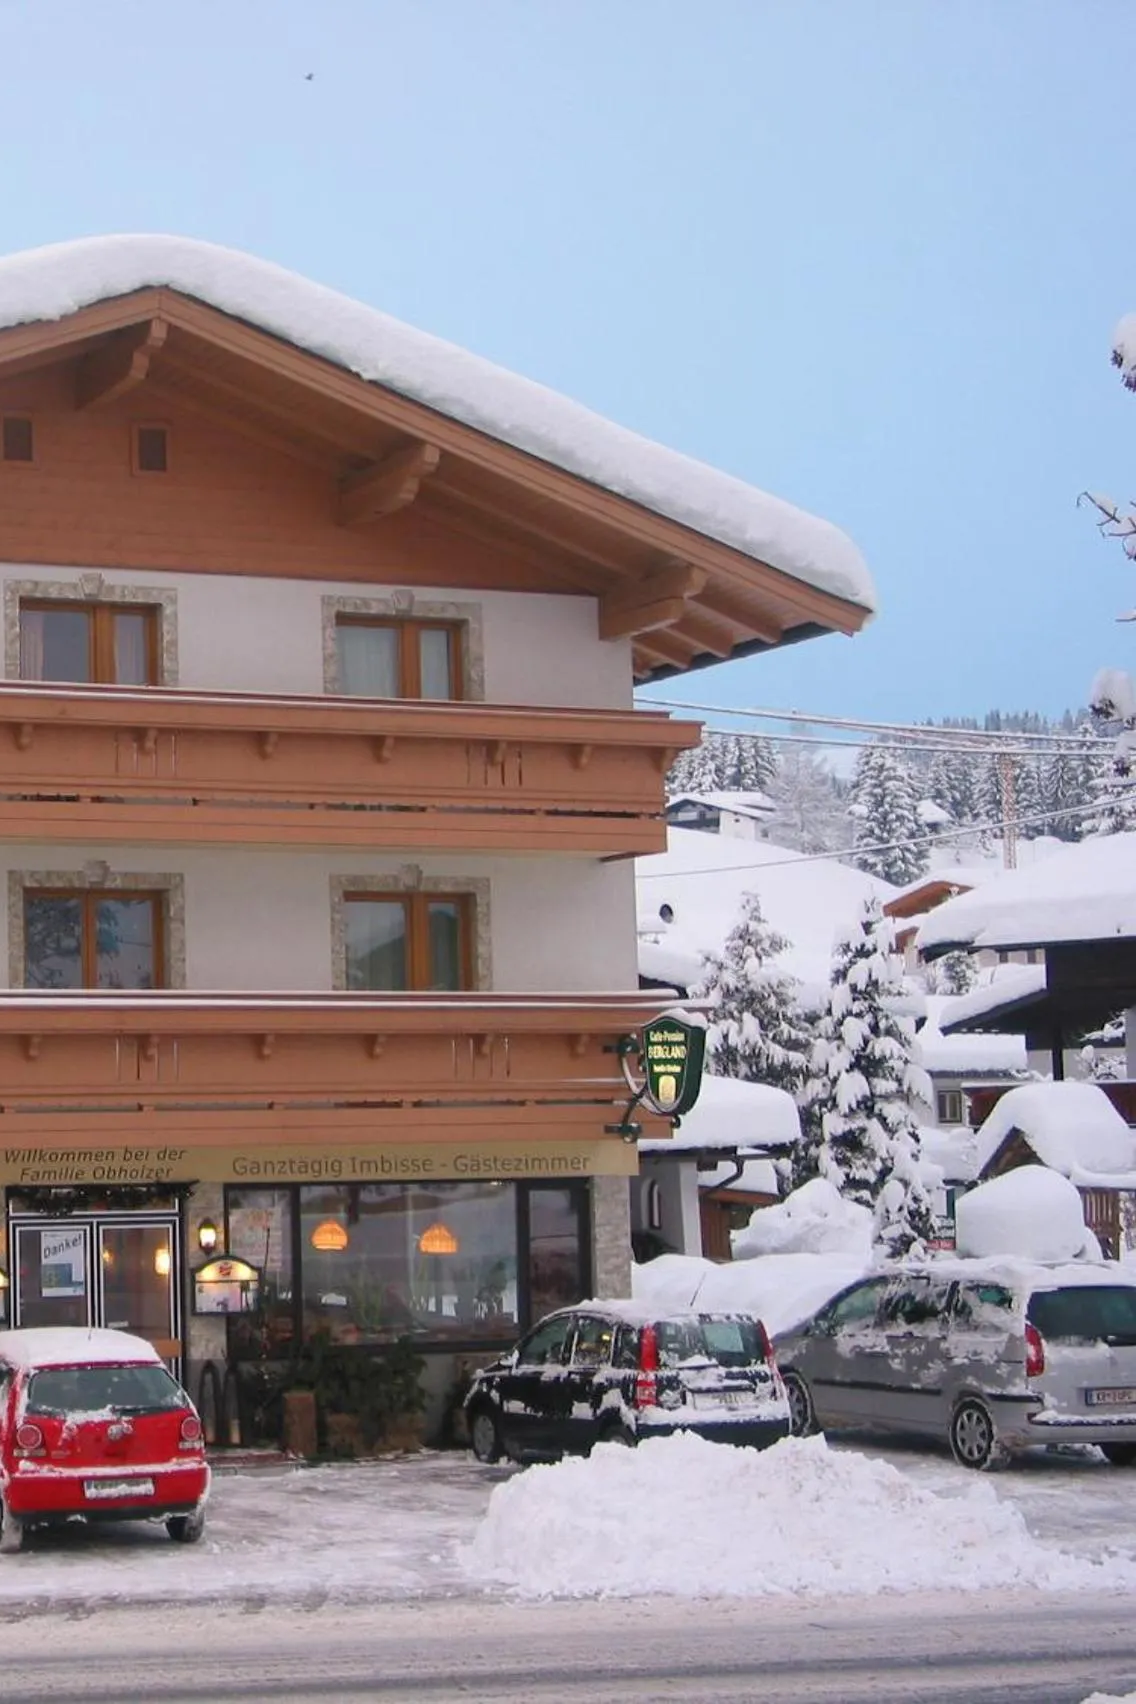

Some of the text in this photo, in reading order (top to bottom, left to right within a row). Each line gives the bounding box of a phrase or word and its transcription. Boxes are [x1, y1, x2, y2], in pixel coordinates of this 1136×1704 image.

[5, 1145, 186, 1164] Willkommen bei der
[20, 1164, 174, 1182] Familie Obholzer
[231, 1154, 343, 1178] Ganztägig
[350, 1155, 435, 1174] Imbisse
[452, 1153, 592, 1173] Gästezimmer
